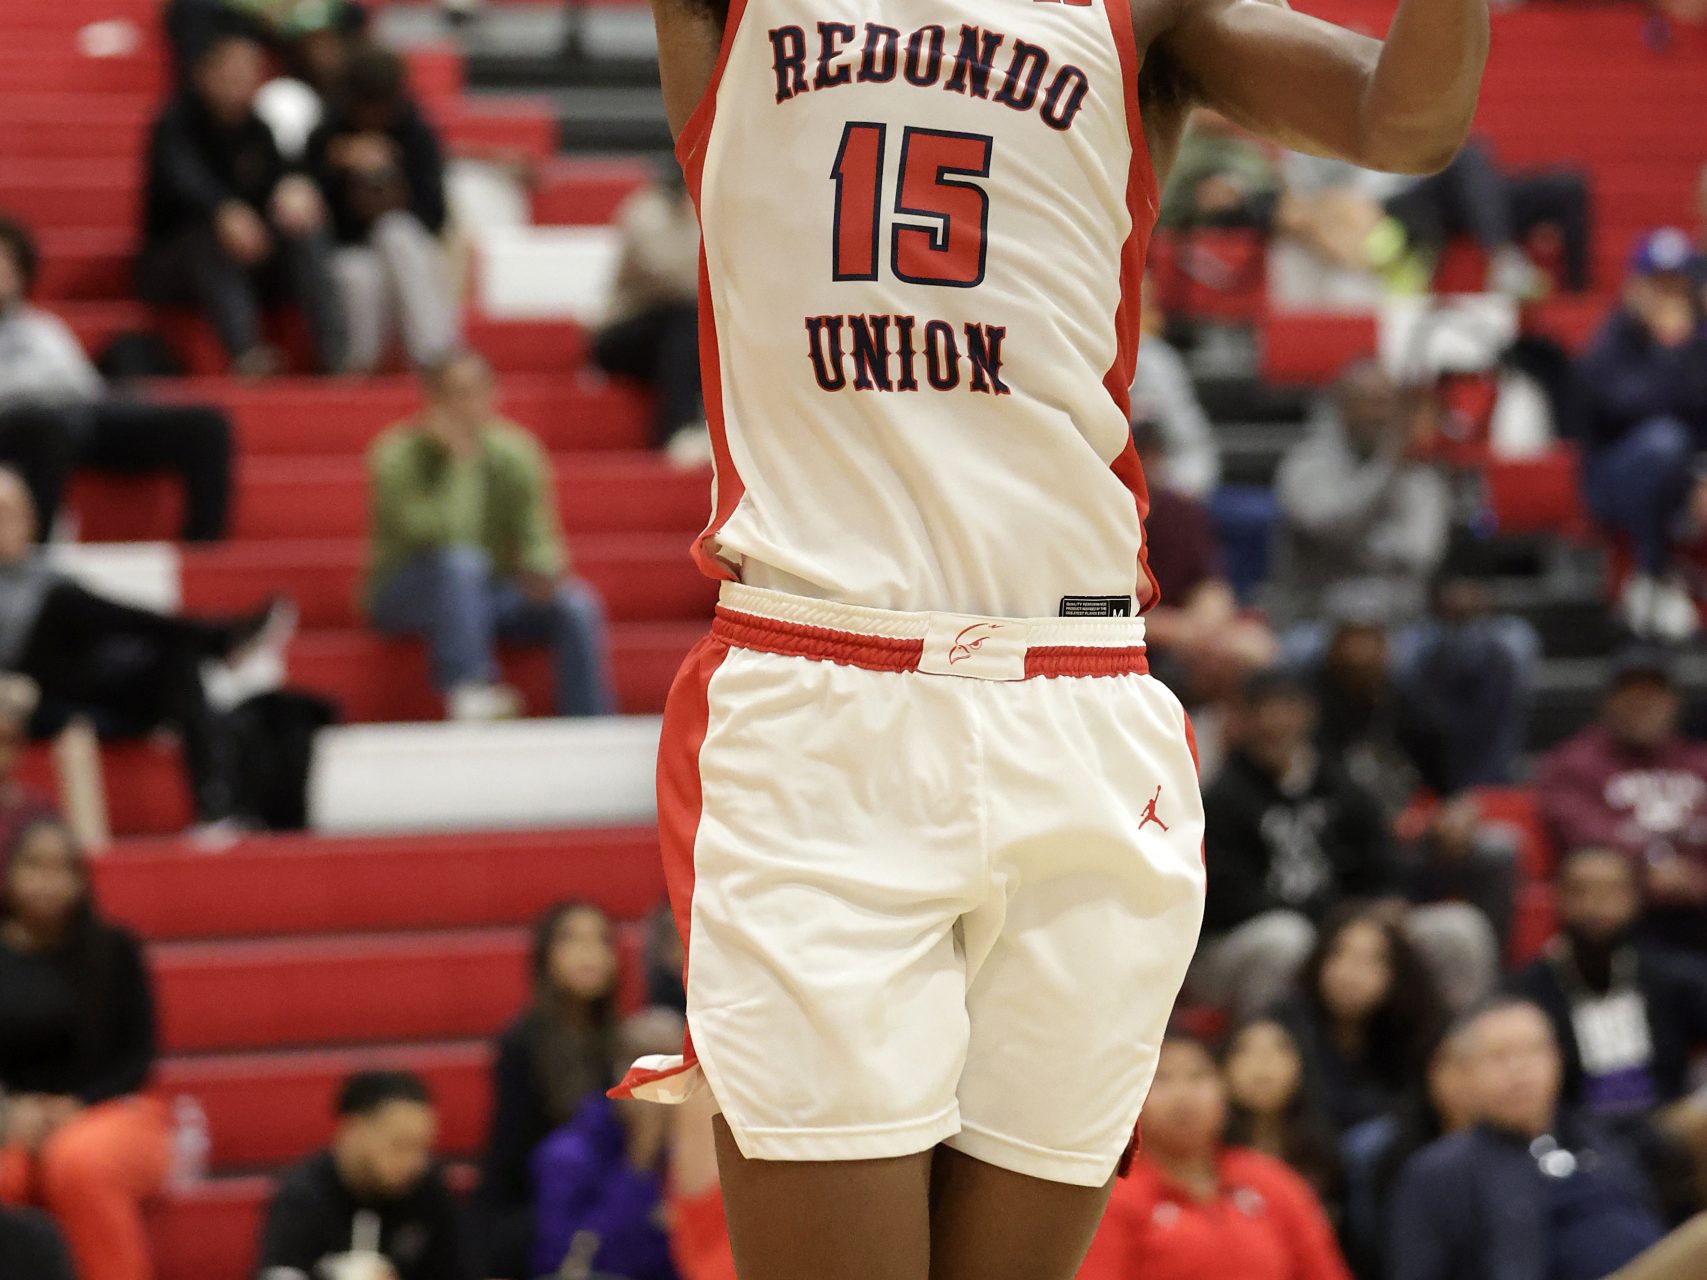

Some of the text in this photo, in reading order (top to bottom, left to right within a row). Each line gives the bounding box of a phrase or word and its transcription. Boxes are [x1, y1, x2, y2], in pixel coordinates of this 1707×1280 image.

[768, 22, 1090, 131] REDONDO
[829, 121, 994, 289] 15
[804, 313, 1010, 395] UNION
